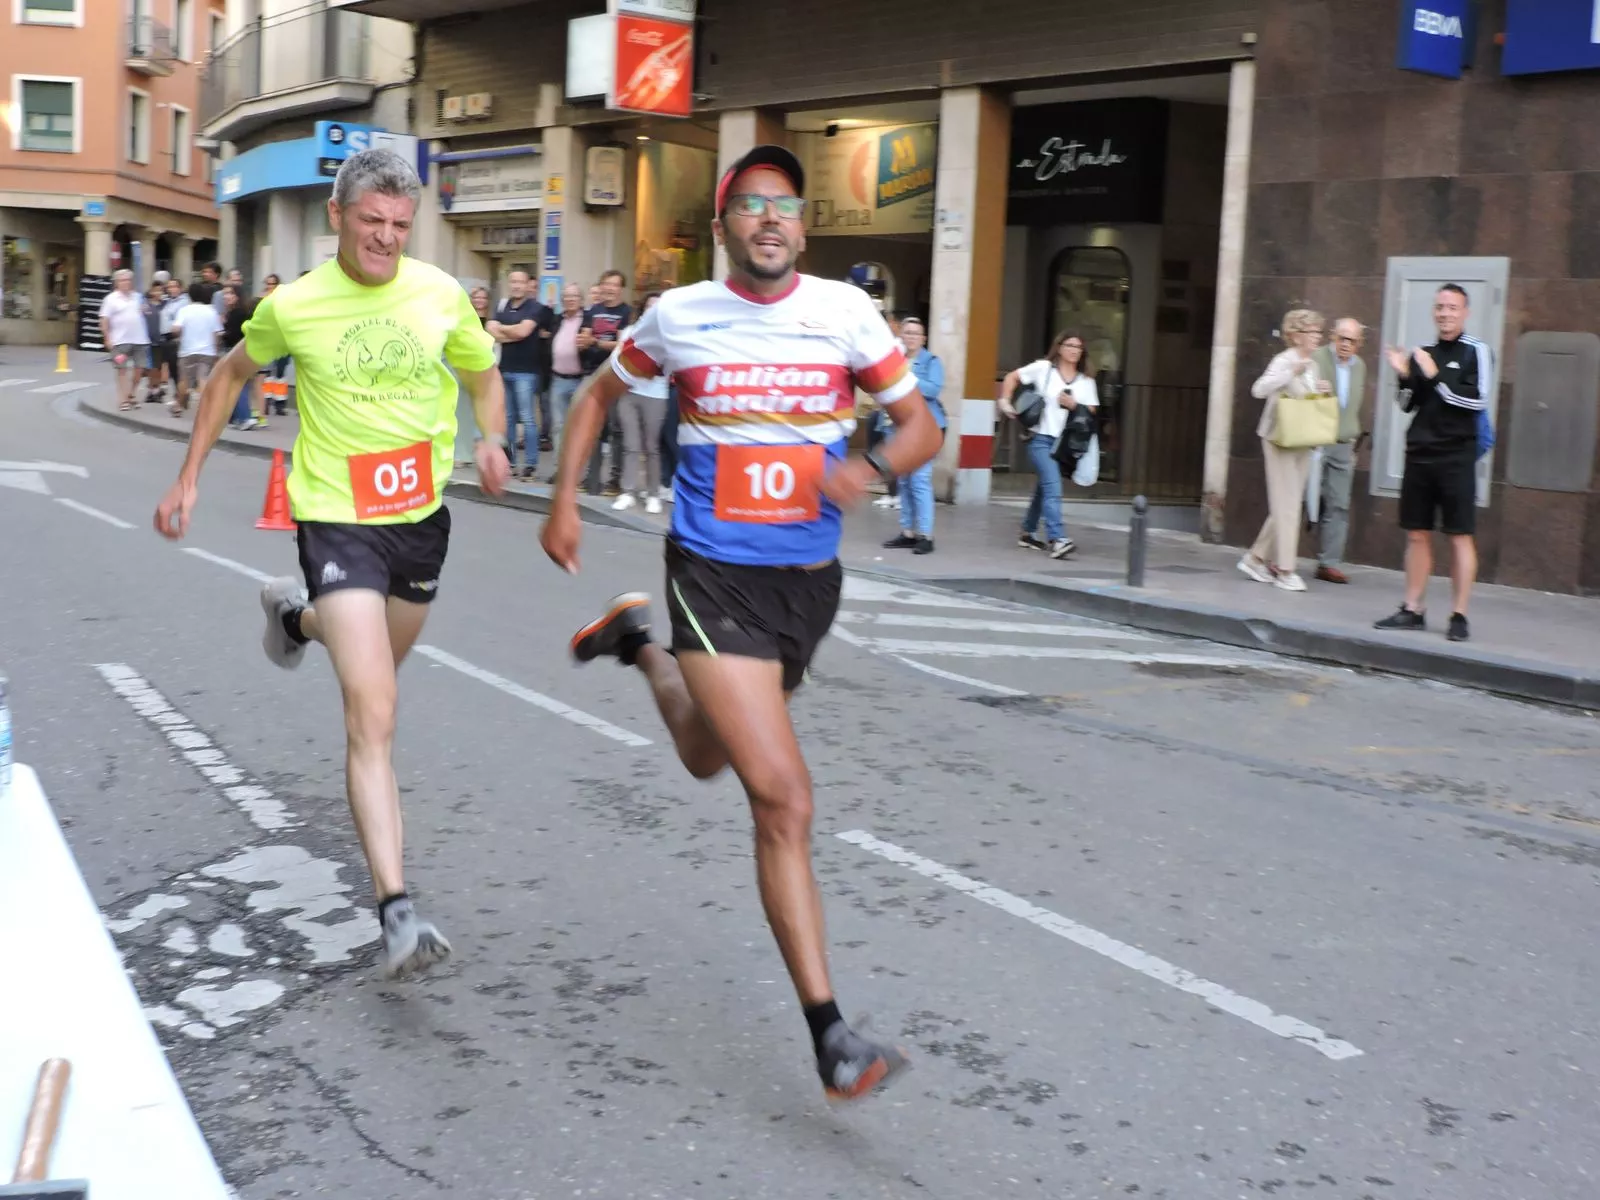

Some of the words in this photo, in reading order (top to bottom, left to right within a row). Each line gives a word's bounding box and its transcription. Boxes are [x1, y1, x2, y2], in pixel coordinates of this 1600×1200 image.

[1413, 8, 1463, 39] BBVA
[810, 199, 872, 228] Elena
[374, 456, 419, 498] 05
[743, 461, 796, 501] 10
